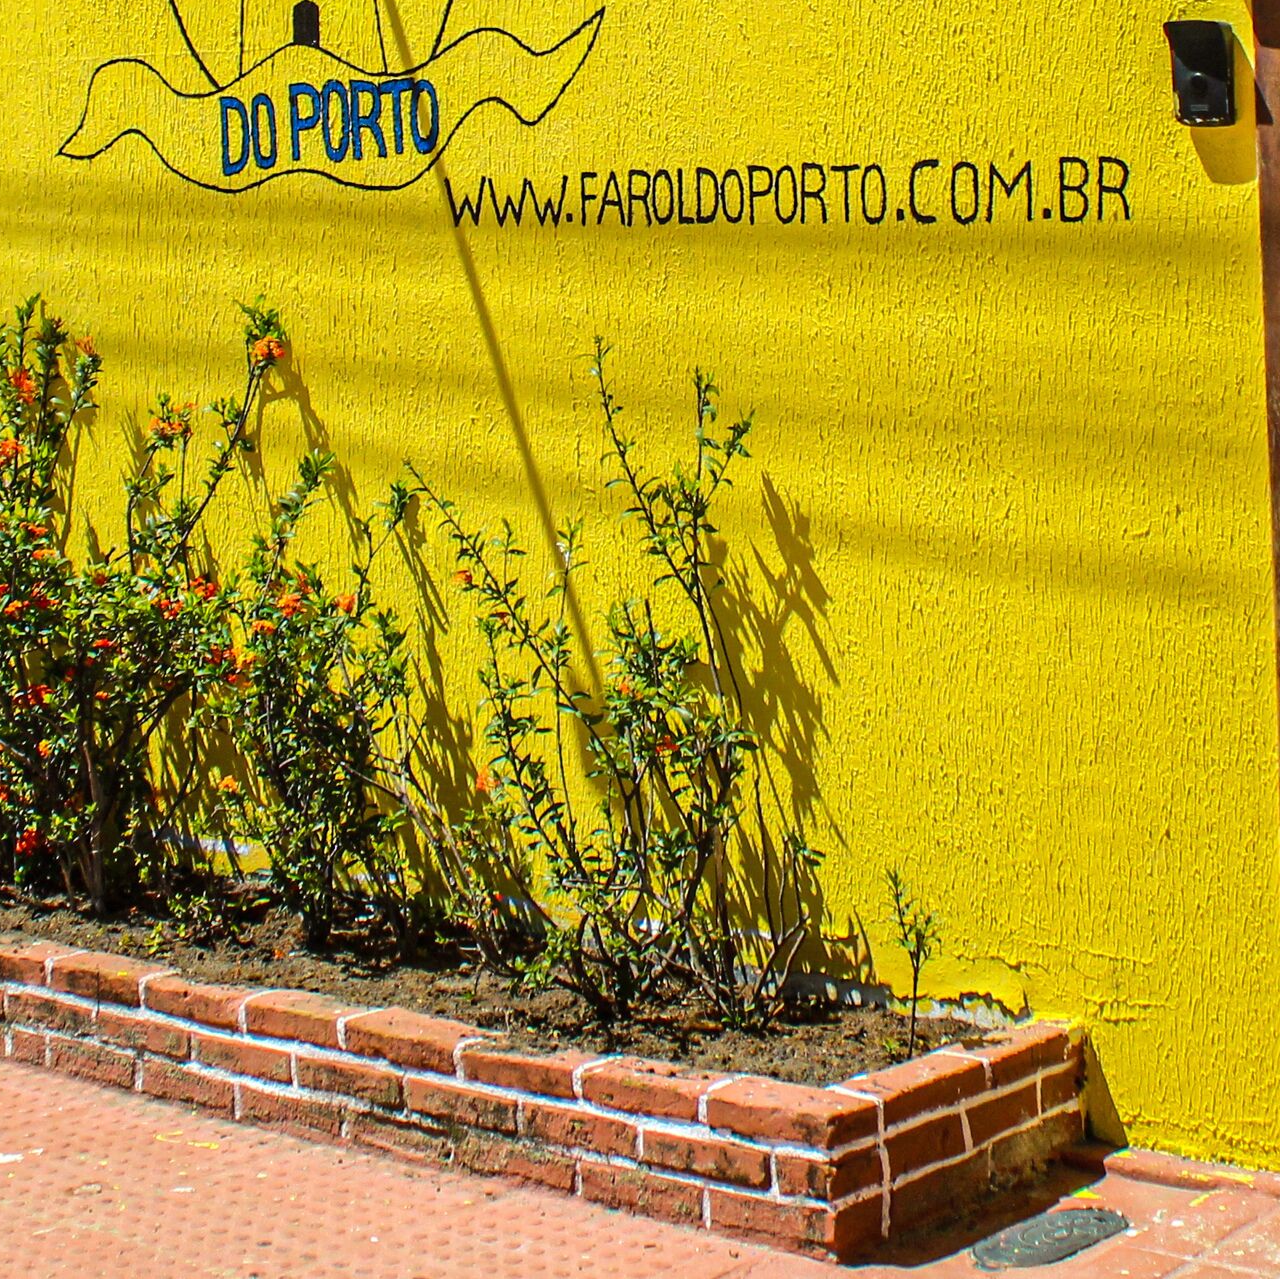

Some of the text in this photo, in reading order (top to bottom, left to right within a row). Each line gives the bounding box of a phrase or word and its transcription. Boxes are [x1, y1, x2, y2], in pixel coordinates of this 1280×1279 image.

[220, 78, 439, 176] DO PORTO
[444, 156, 1131, 228] WWW.FAROLDOPORTO.COM.BR
